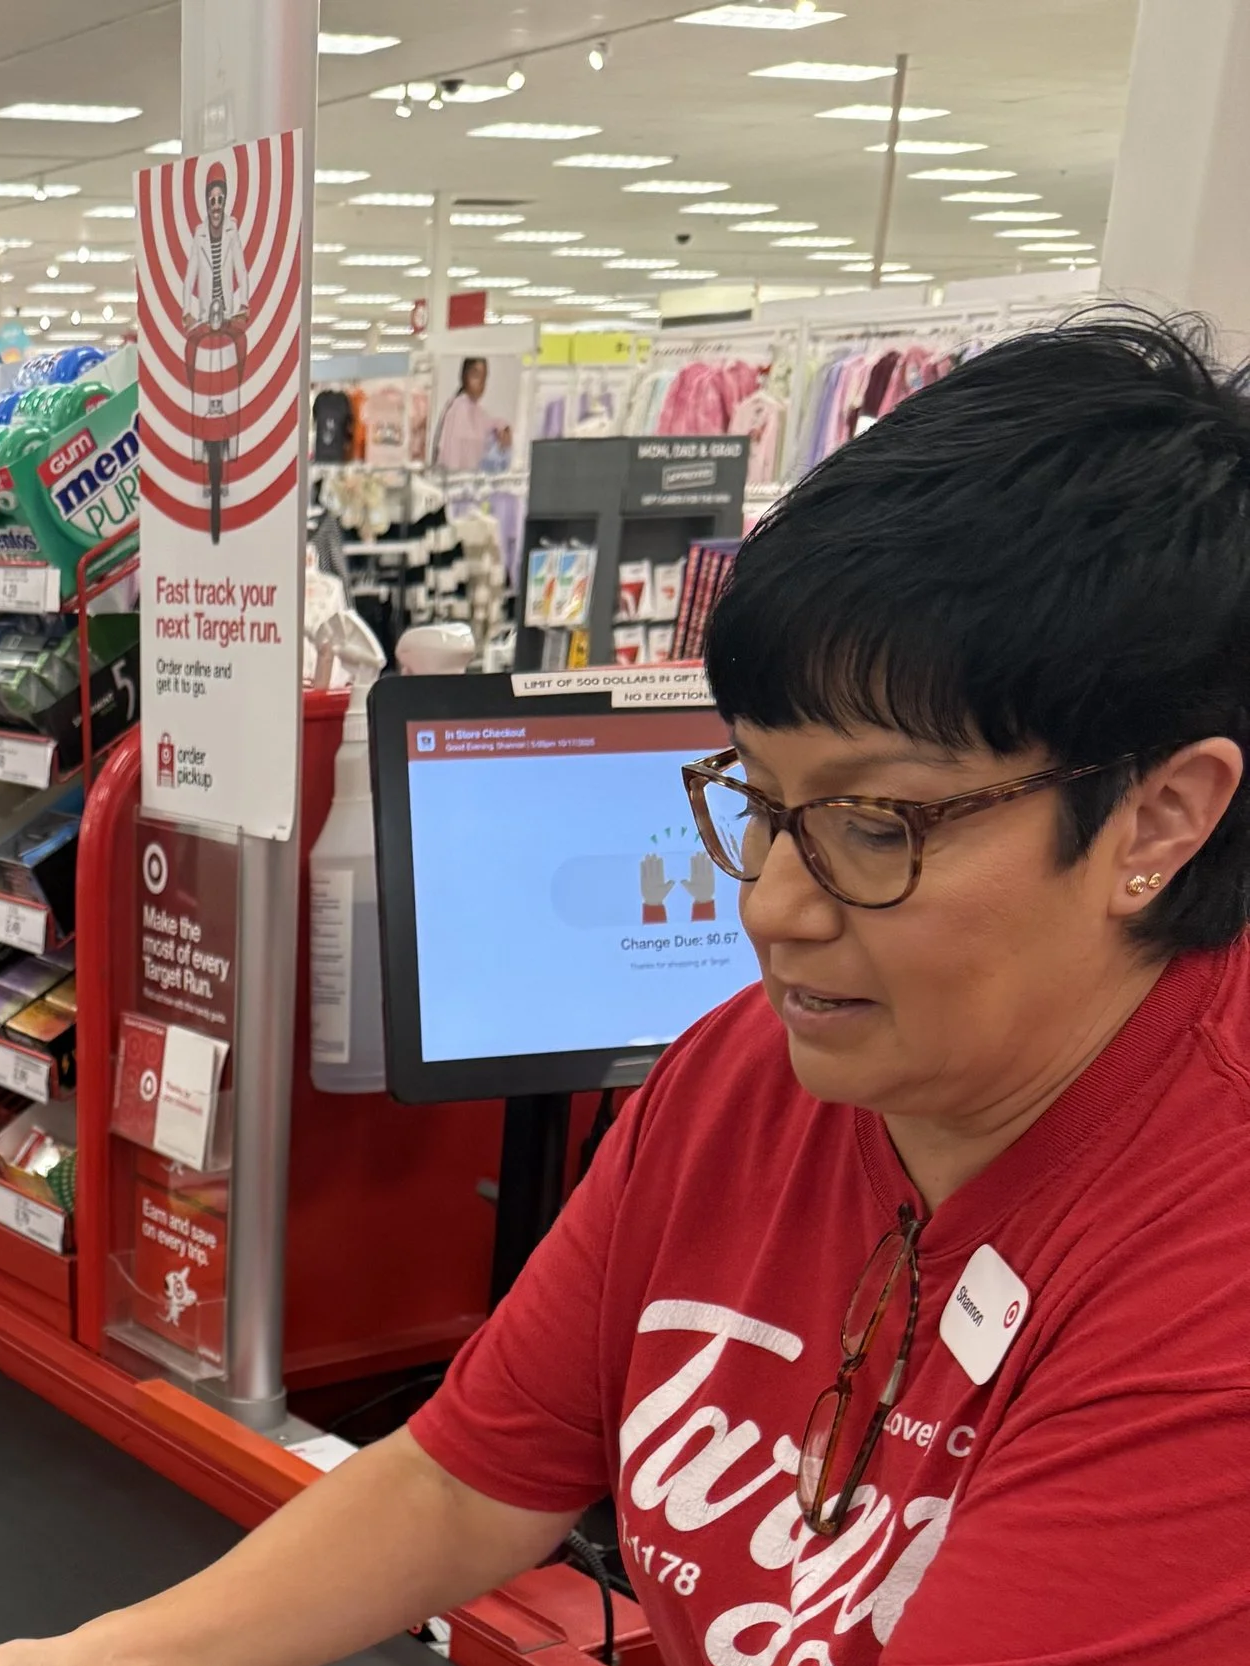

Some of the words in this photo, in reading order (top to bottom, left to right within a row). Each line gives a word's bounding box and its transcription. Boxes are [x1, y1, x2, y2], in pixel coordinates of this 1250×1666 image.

[55, 424, 139, 516] men
[156, 576, 189, 604] Fast
[194, 577, 236, 606] track
[240, 584, 277, 613] your
[156, 613, 190, 639] next
[194, 612, 246, 648] Target
[250, 621, 281, 644] run.
[156, 658, 182, 675] Order
[184, 660, 211, 678] online
[213, 662, 232, 679] and
[156, 678, 171, 695] get
[173, 676, 180, 694] it
[181, 679, 191, 694] to
[524, 680, 551, 689] LIMIT
[556, 678, 572, 687] OF
[577, 677, 599, 686] 500
[603, 674, 655, 685] DOLLARS
[659, 674, 670, 683] IN
[674, 673, 698, 683] GIFT
[624, 692, 641, 701] NO
[444, 730, 454, 740] In
[456, 729, 481, 740] Store
[482, 727, 526, 738] Checkout
[177, 746, 206, 765] order
[177, 767, 213, 791] pickup
[143, 905, 178, 936] Make
[180, 916, 201, 943] the
[620, 937, 671, 952] Change
[674, 934, 703, 948] Due:
[706, 932, 739, 946] $0.67
[143, 936, 175, 962] most
[177, 942, 191, 966] of
[192, 950, 230, 983] every
[143, 955, 182, 990] Target
[183, 968, 213, 999] Run.
[142, 1198, 167, 1225] Earn
[169, 1214, 190, 1237] and
[191, 1224, 217, 1249] save
[142, 1221, 156, 1241] on
[157, 1229, 186, 1258] every
[187, 1240, 210, 1267] trip.
[956, 1285, 984, 1327] Shannon
